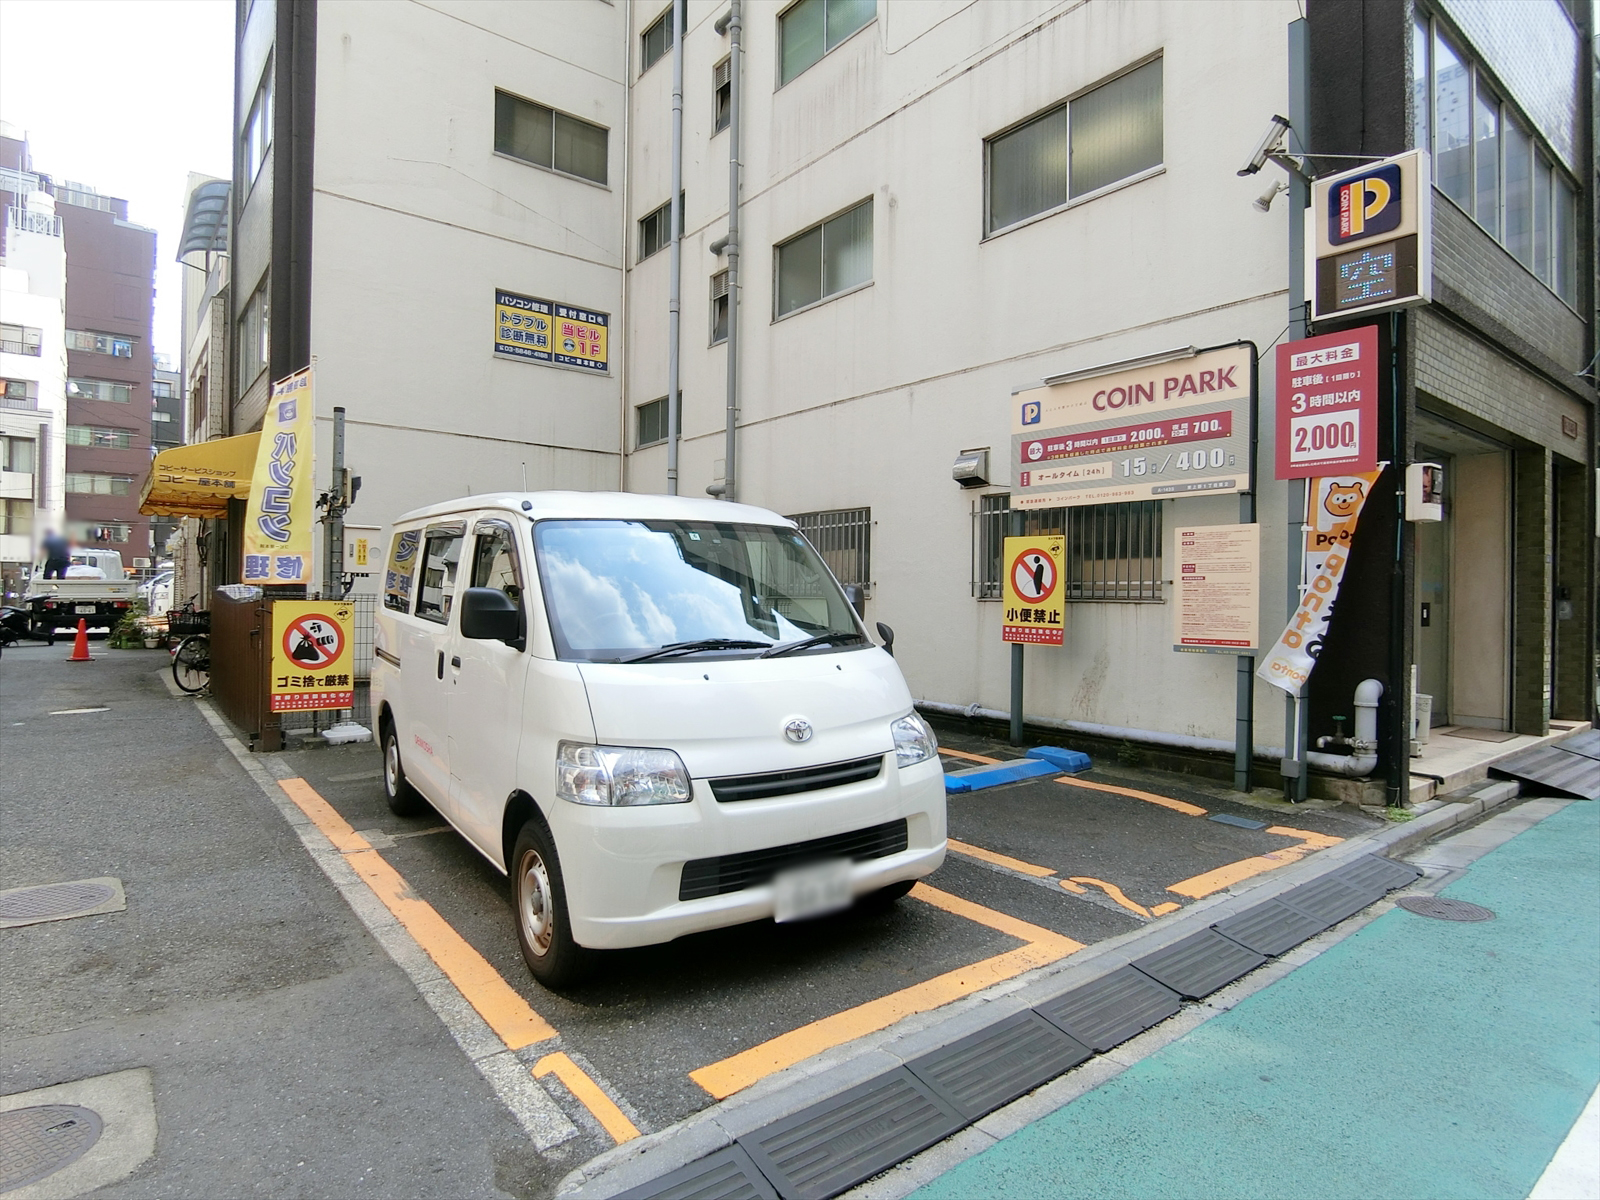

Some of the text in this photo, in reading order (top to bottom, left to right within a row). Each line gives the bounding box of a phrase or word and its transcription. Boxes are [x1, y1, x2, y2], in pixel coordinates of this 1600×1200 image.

[1340, 188, 1350, 235] COIN PARK
[1340, 252, 1393, 303] 空
[500, 296, 549, 314] パソコン修理
[500, 310, 548, 331] トラブル
[500, 326, 547, 348] 診断無料
[562, 322, 601, 342] 当ビル
[579, 341, 600, 356] 1F
[1296, 347, 1353, 367] 最大料金
[1092, 365, 1238, 411] COIN PARK
[1291, 373, 1323, 388] 駐車後
[1291, 389, 1361, 413] 3時間以内
[1295, 421, 1357, 453] 2,000円
[158, 464, 237, 478] コピーサービスショップ
[1038, 470, 1080, 481] オールタイム
[1006, 608, 1061, 624] 小便禁止
[277, 674, 349, 688] ゴミ捨て厳禁
[1058, 875, 1182, 919] 2
[530, 1049, 642, 1147] 1
